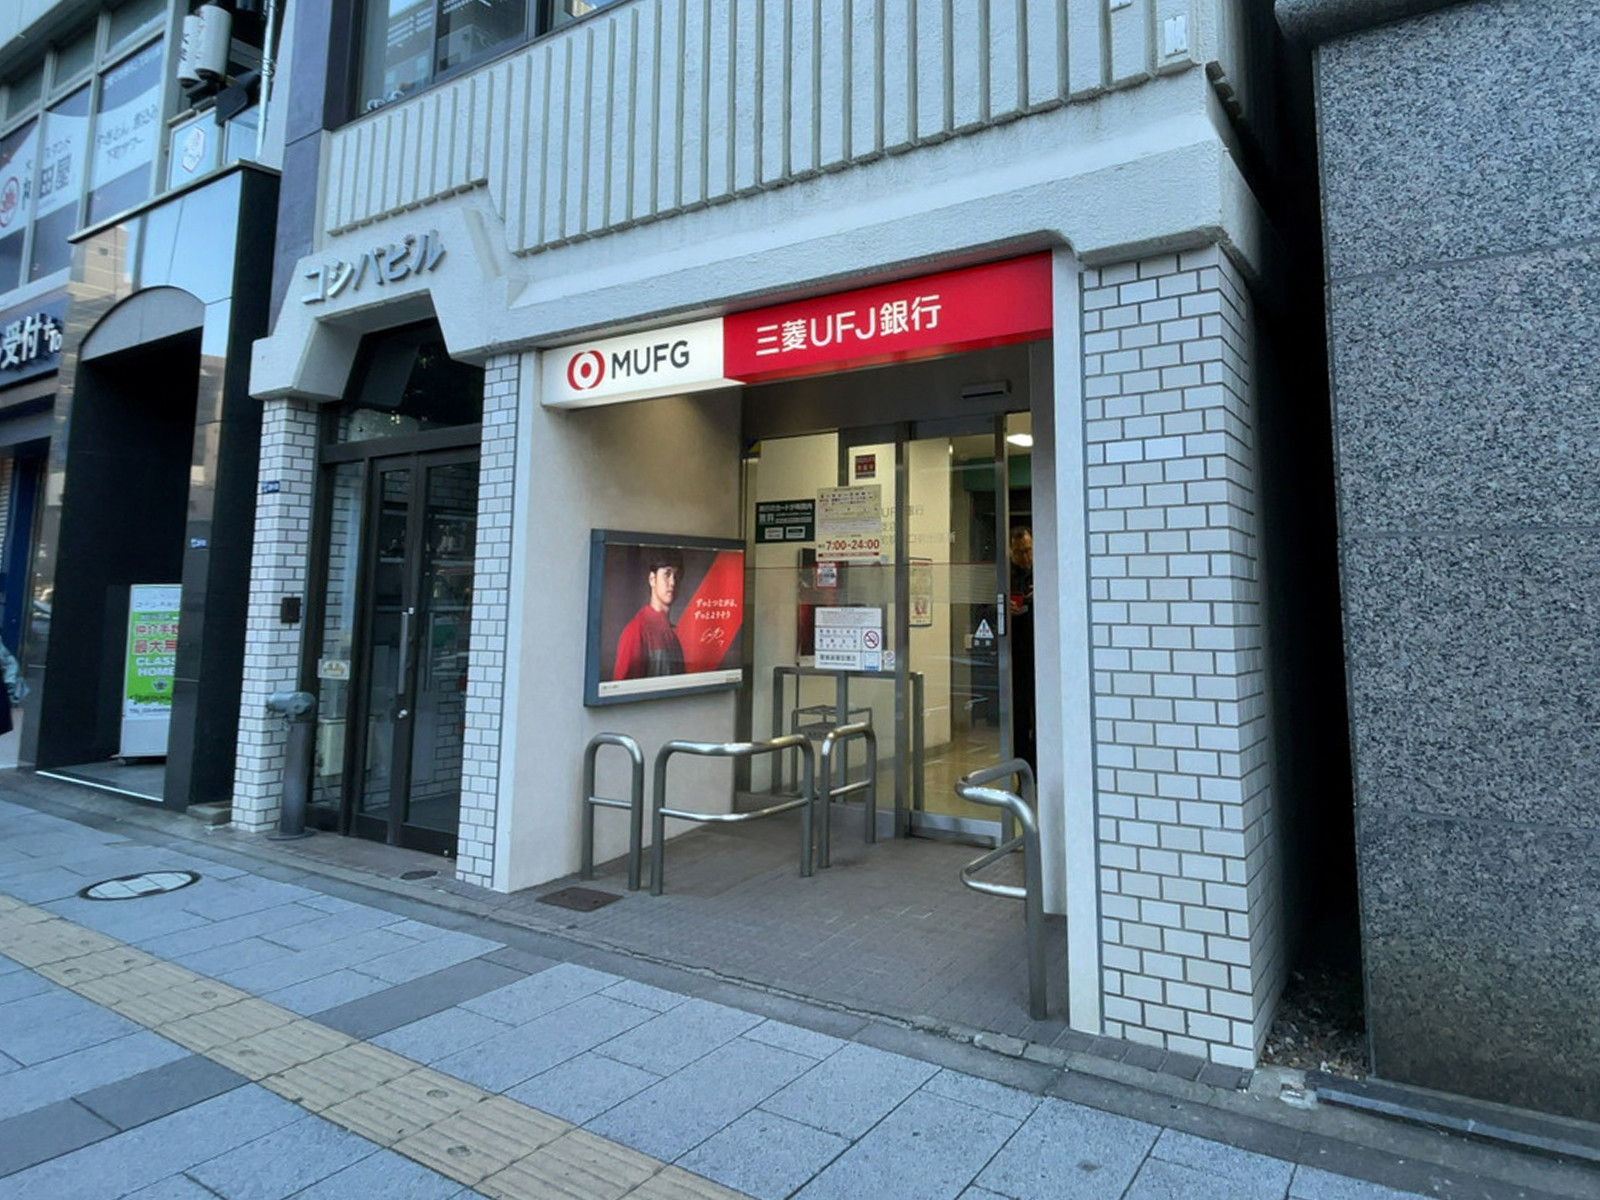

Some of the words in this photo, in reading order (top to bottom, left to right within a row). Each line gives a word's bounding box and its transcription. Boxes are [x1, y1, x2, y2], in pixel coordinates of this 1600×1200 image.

[756, 294, 942, 357] 三菱UFJ銀行
[611, 339, 690, 380] MUFG
